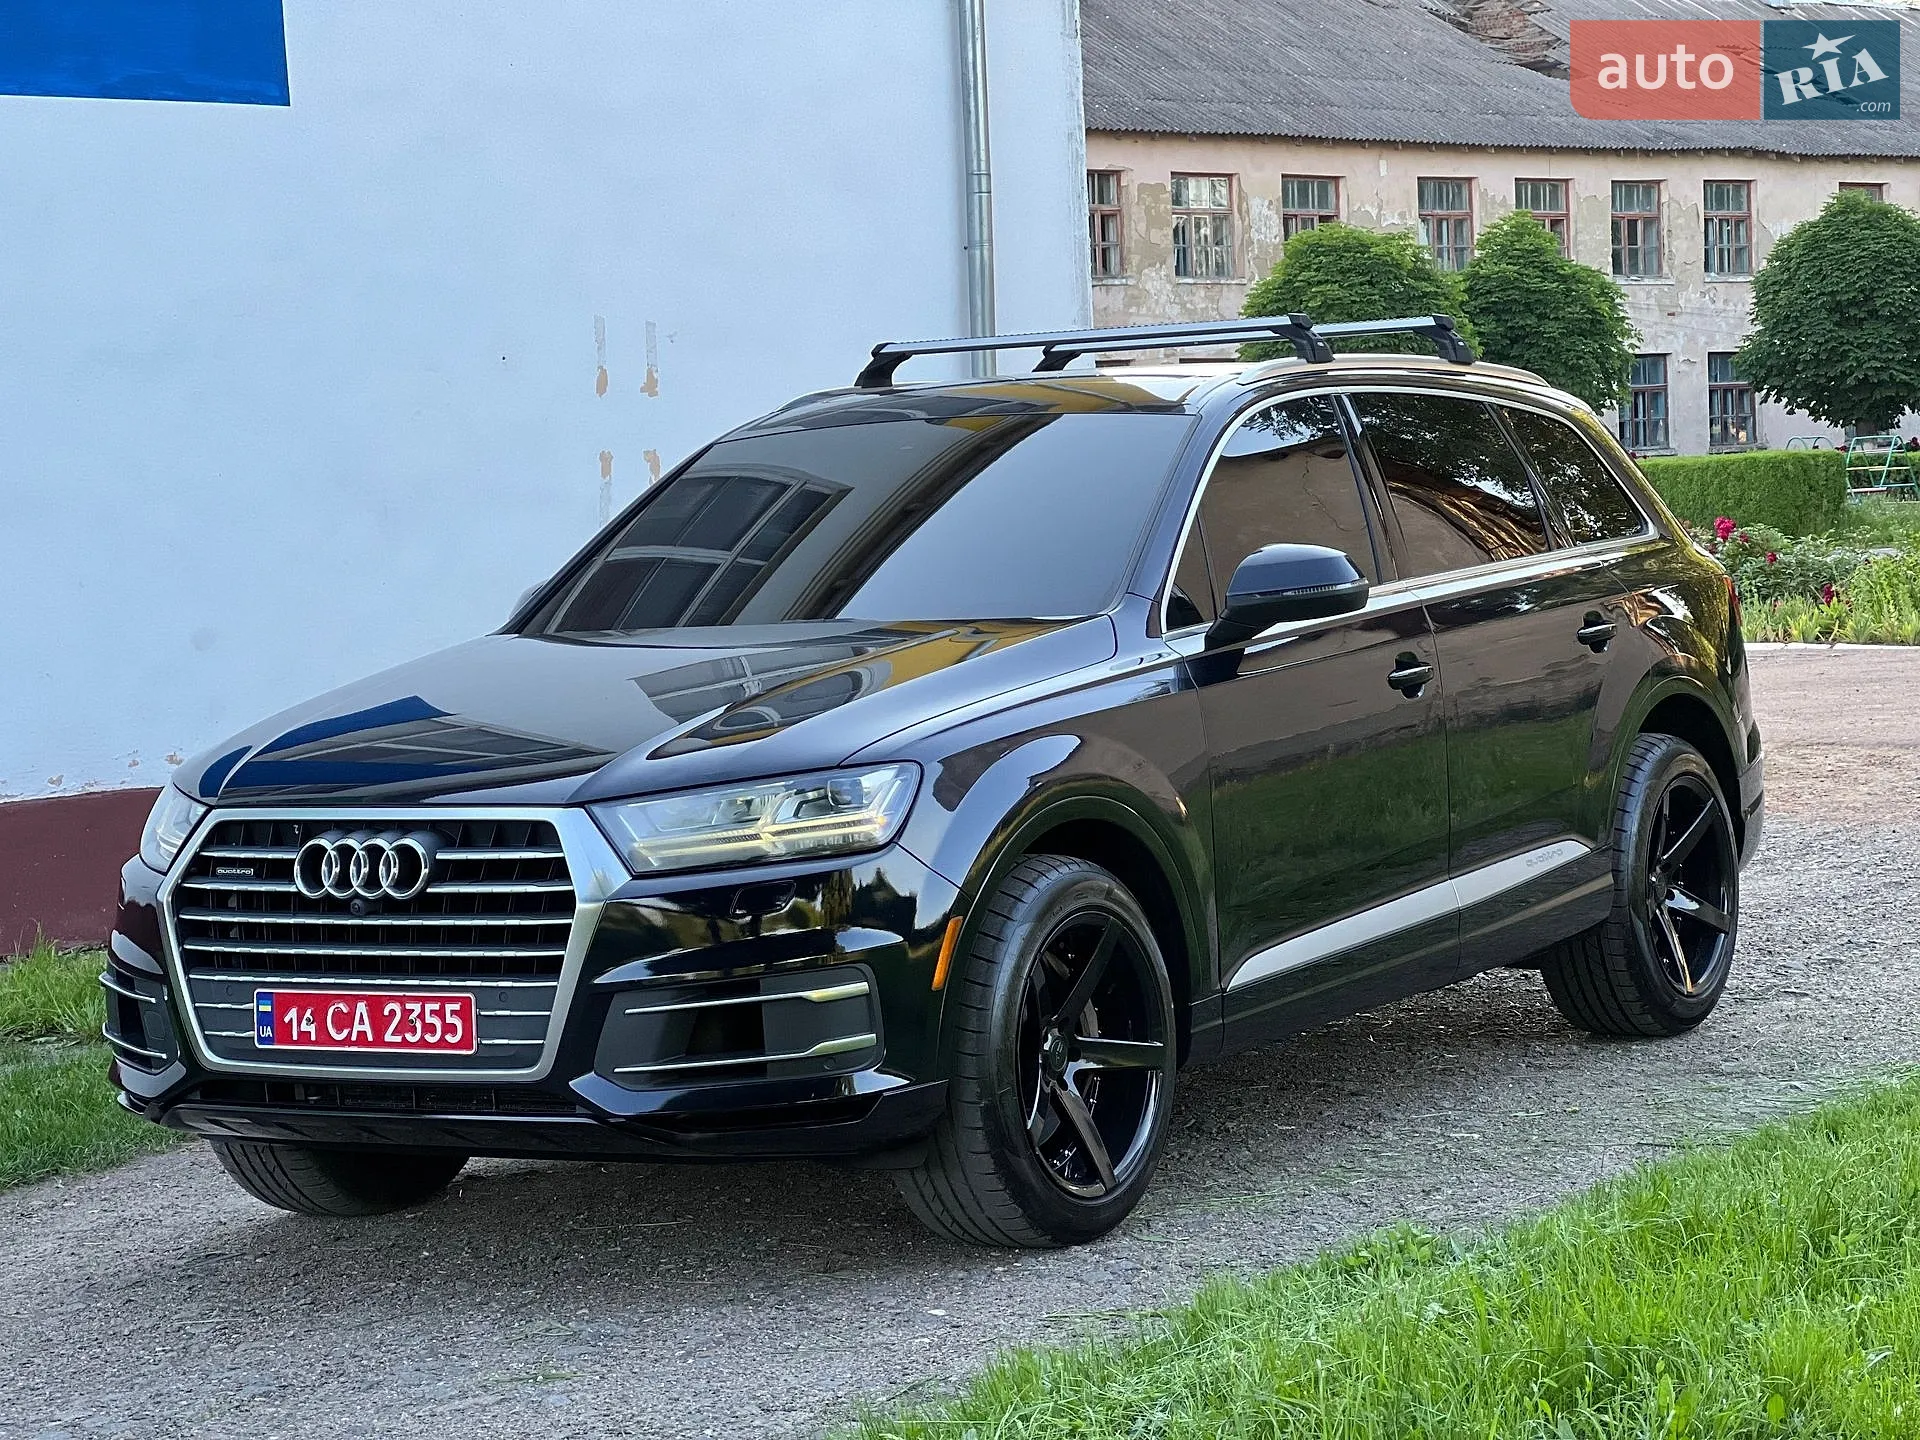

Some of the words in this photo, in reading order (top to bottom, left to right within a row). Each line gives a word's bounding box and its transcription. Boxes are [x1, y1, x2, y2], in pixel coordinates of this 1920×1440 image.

[259, 1025, 273, 1038] UA
[283, 1006, 317, 1042] 14
[326, 1001, 374, 1042] CA
[383, 1001, 463, 1044] 2355
